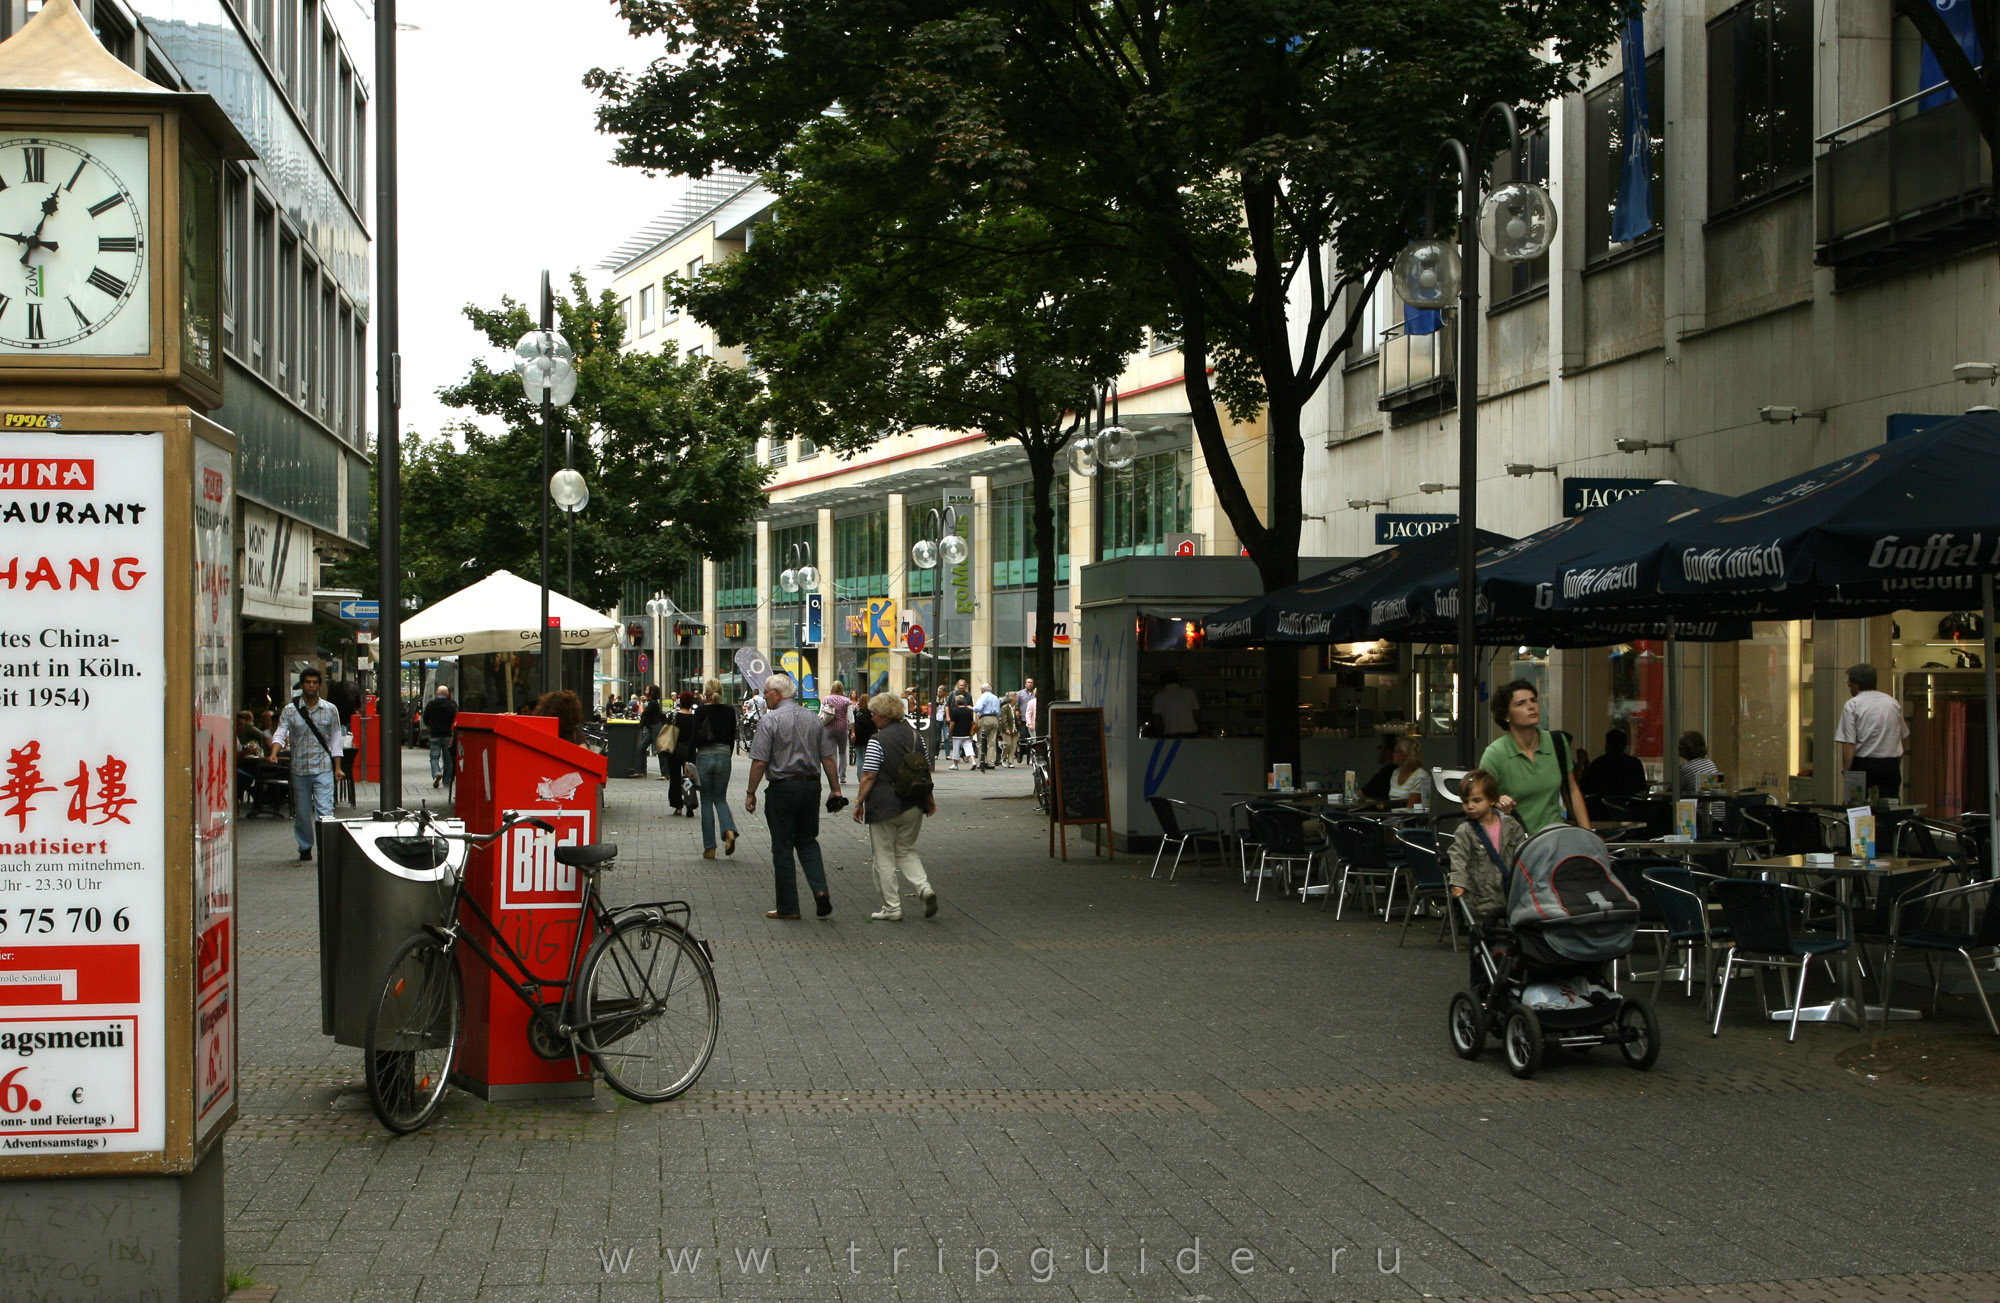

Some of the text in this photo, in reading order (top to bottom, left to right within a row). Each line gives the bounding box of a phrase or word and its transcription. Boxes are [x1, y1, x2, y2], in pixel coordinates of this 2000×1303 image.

[5, 414, 47, 428] 1996
[0, 501, 146, 525] AURANT
[1867, 532, 1982, 571] Gaffel
[1683, 546, 1732, 584] Gaffel
[39, 628, 119, 648] China-
[520, 629, 590, 640] GATRO
[0, 657, 142, 678] ant in Köln.
[0, 687, 90, 711] it 1954)
[0, 858, 145, 872] auch zum mitnehmen.
[35, 878, 72, 891] 23.30
[77, 878, 102, 890] Uhr
[19, 907, 55, 934] 75
[66, 906, 102, 933] 70
[113, 905, 130, 933] 6
[22, 973, 61, 982] Sandkaul
[1, 1024, 124, 1057] agsmenü
[71, 1086, 84, 1104] €
[31, 1115, 52, 1126] und
[56, 1114, 107, 1127] Feiertags
[2, 1138, 99, 1149] Adventssamstags
